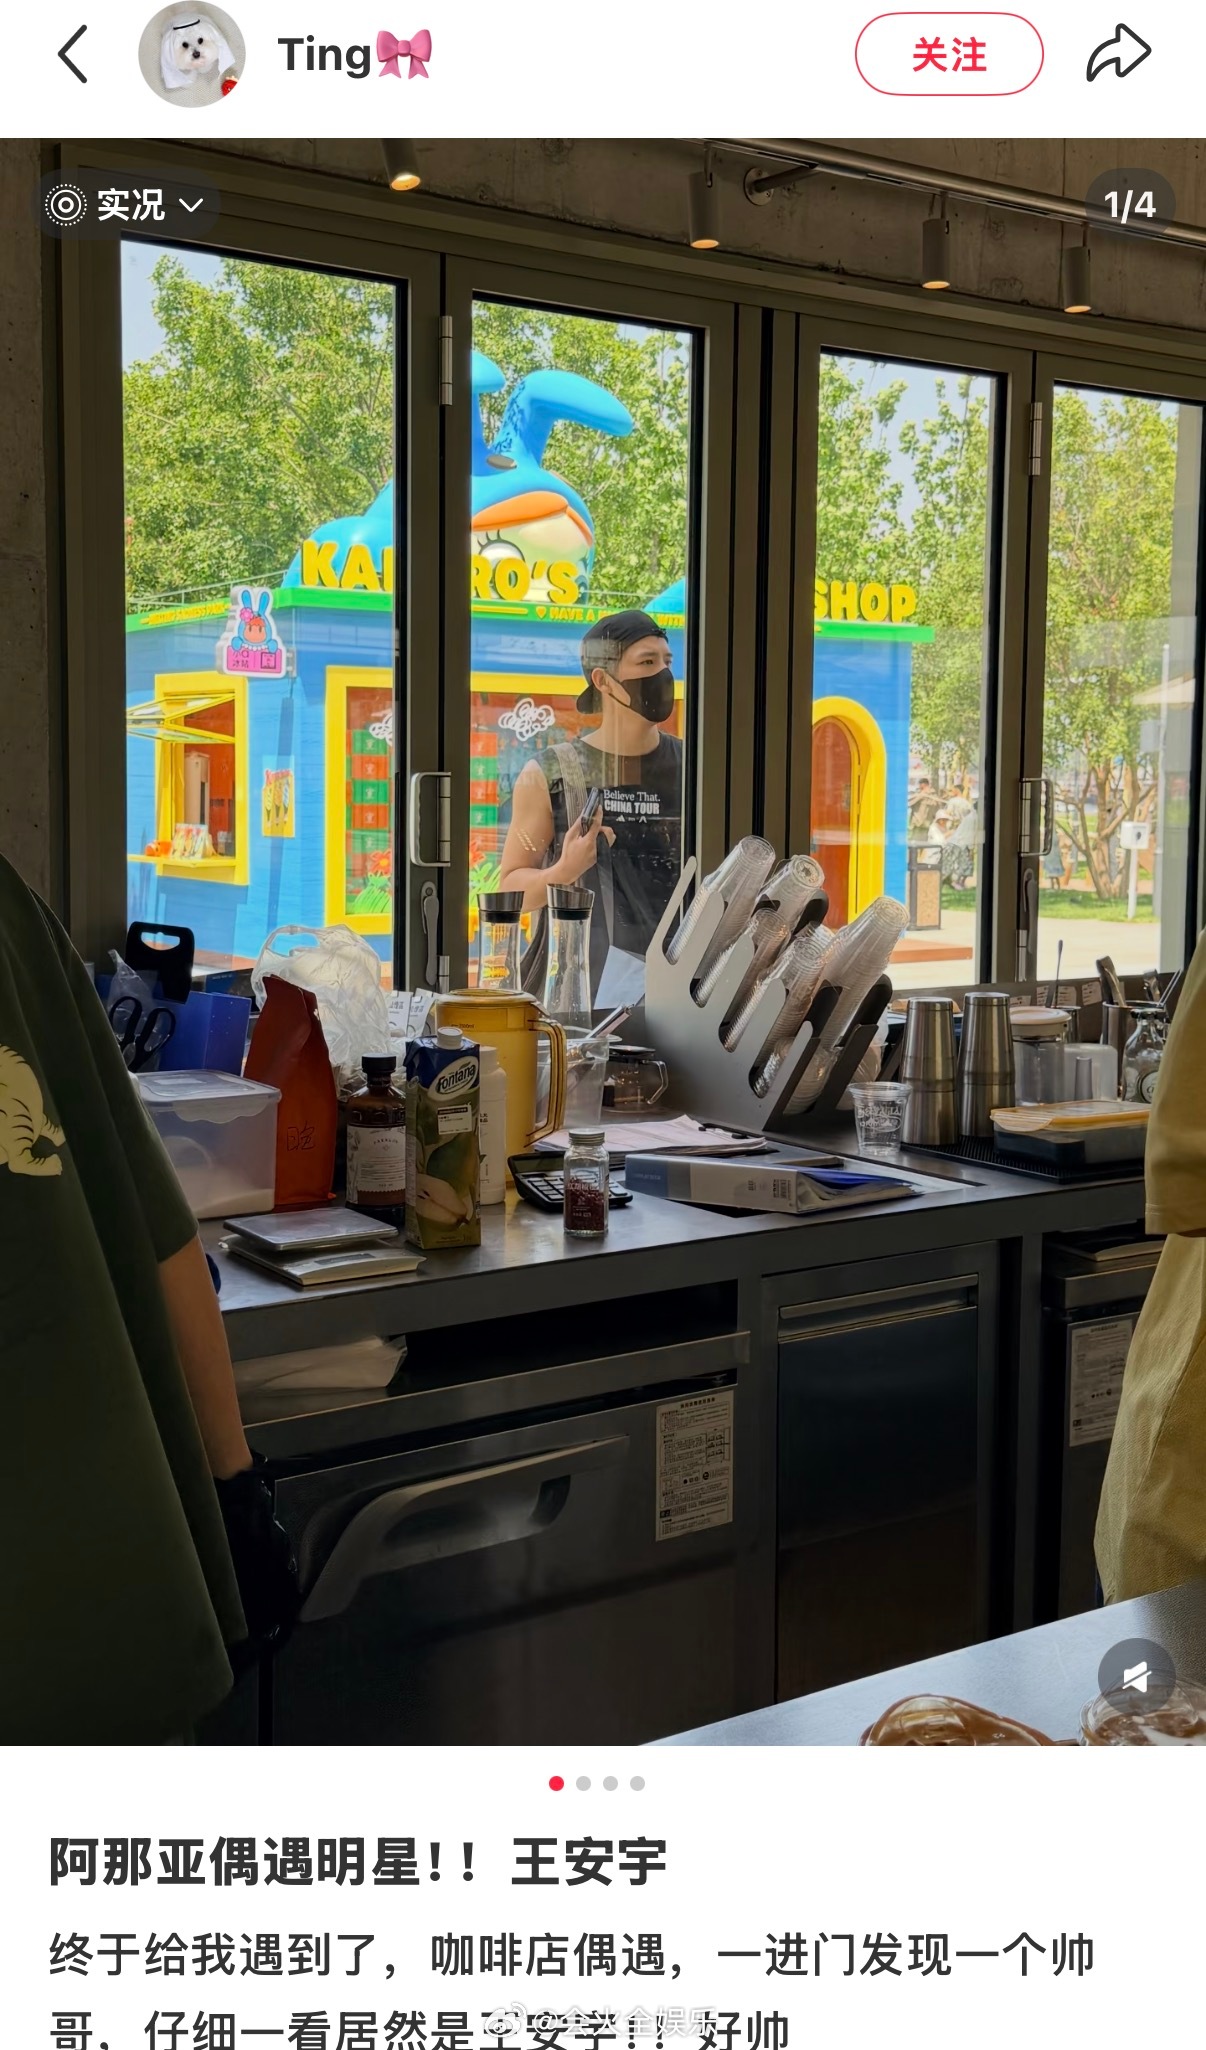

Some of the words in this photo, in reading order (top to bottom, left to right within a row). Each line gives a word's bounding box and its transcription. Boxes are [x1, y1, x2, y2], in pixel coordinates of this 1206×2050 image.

[603, 789, 635, 801] Believe
[636, 791, 661, 802] That.
[604, 800, 632, 814] CHINA
[634, 802, 660, 815] TOUR
[436, 1064, 476, 1093] Fontana
